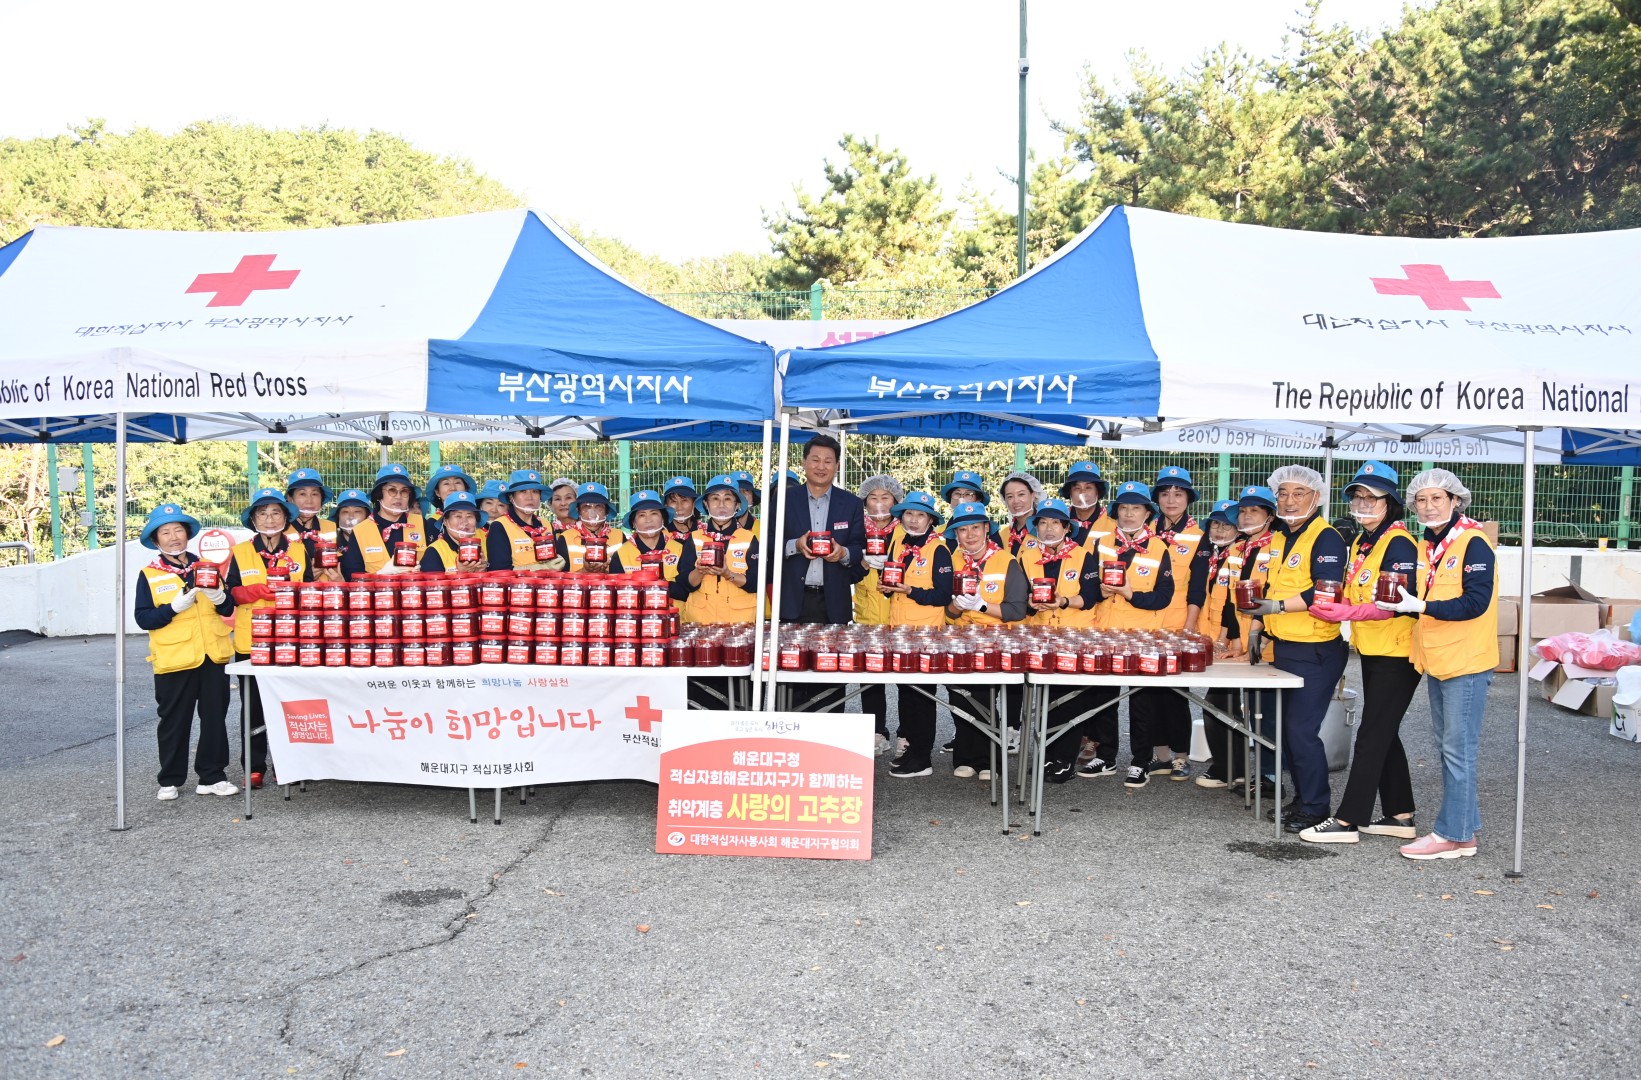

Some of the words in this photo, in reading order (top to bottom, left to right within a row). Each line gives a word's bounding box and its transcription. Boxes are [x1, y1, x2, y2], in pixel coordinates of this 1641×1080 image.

[205, 315, 354, 329] 부산광역시지사
[0, 379, 29, 404] blic
[34, 376, 51, 403] of
[63, 375, 114, 401] Korea
[126, 372, 200, 398] National
[210, 371, 248, 398] Red
[253, 371, 308, 397] Cross
[498, 372, 693, 404] 부산광역시지사
[1272, 381, 1312, 409] The
[1319, 381, 1413, 416] Republic
[1420, 381, 1445, 410] of
[1457, 381, 1525, 411] Korea
[1542, 381, 1629, 413] National
[366, 680, 397, 690] 어려운
[402, 679, 432, 690] 이웃과
[435, 678, 476, 689] 함께하는
[481, 678, 523, 688] 희망나눔
[527, 678, 569, 688] 사랑실천
[289, 721, 328, 732] 적십자는
[348, 706, 434, 740] 나눔이
[445, 705, 602, 740] 희망입니다
[622, 733, 661, 748] 부산적십
[420, 761, 468, 775] 해운대지구
[472, 761, 535, 775] 적십자봉사회
[733, 751, 800, 767] 해운대구청
[670, 769, 804, 788] 적십자회해운대지구가
[809, 773, 863, 790] 함께하는
[668, 799, 723, 819] 취약계층
[727, 793, 791, 823] 사랑의
[797, 795, 863, 824] 고추장
[690, 833, 778, 848] 대한적십자사봉사회
[780, 836, 860, 851] 해운대지구협의회
